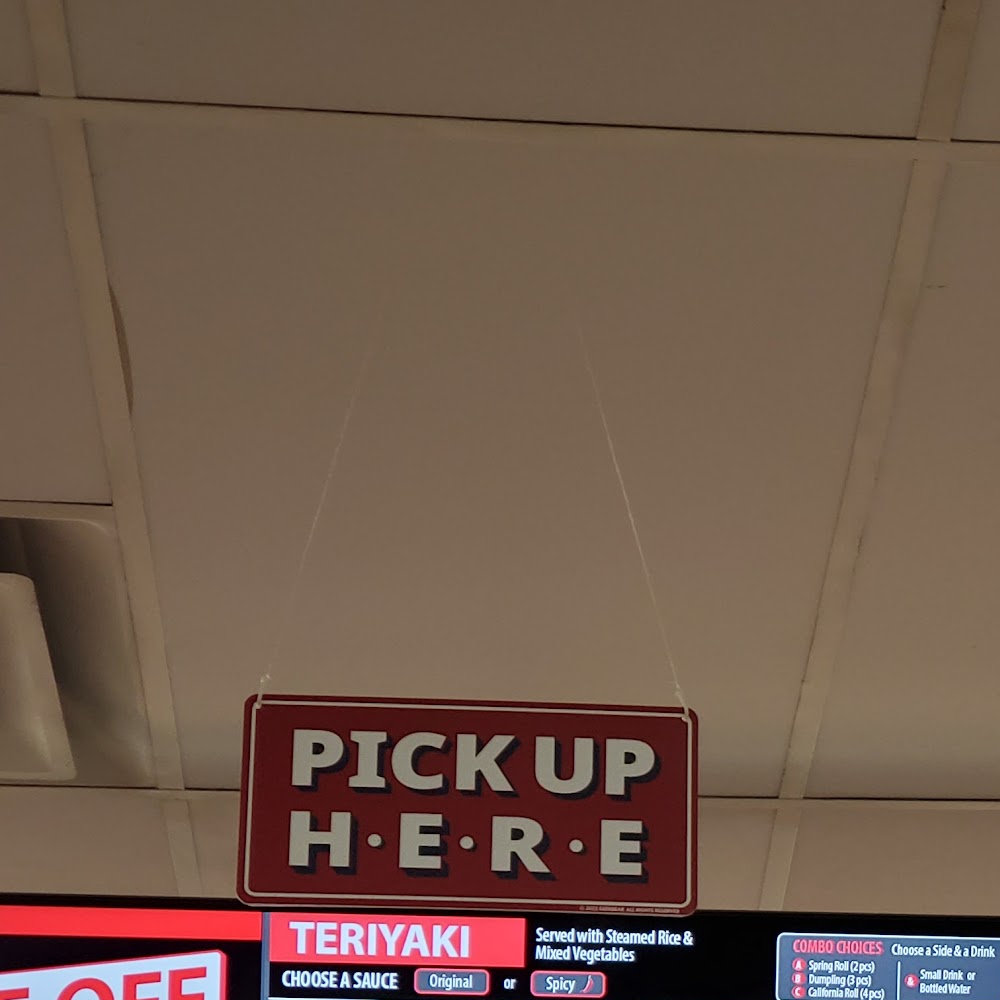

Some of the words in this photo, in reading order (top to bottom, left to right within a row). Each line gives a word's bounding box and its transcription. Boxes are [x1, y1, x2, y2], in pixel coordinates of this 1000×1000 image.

[292, 729, 516, 792] PICK
[534, 736, 657, 795] UP
[289, 921, 470, 958] TERIYAKI
[536, 928, 574, 943] Served
[576, 929, 603, 943] with
[605, 930, 655, 944] Steamed
[658, 931, 681, 945] Rice
[683, 932, 693, 945] &
[536, 946, 570, 962] Mixed
[572, 947, 635, 964] Vegetables
[793, 940, 833, 954] COMBO
[837, 941, 883, 954] CHOICES
[282, 971, 338, 987] CHOOSE
[340, 973, 350, 987] A
[353, 973, 398, 989] SAUCE
[430, 974, 472, 991] Original
[504, 978, 516, 989] or
[546, 976, 575, 994] Spicy
[808, 986, 843, 998] California
[844, 988, 858, 998] Roll
